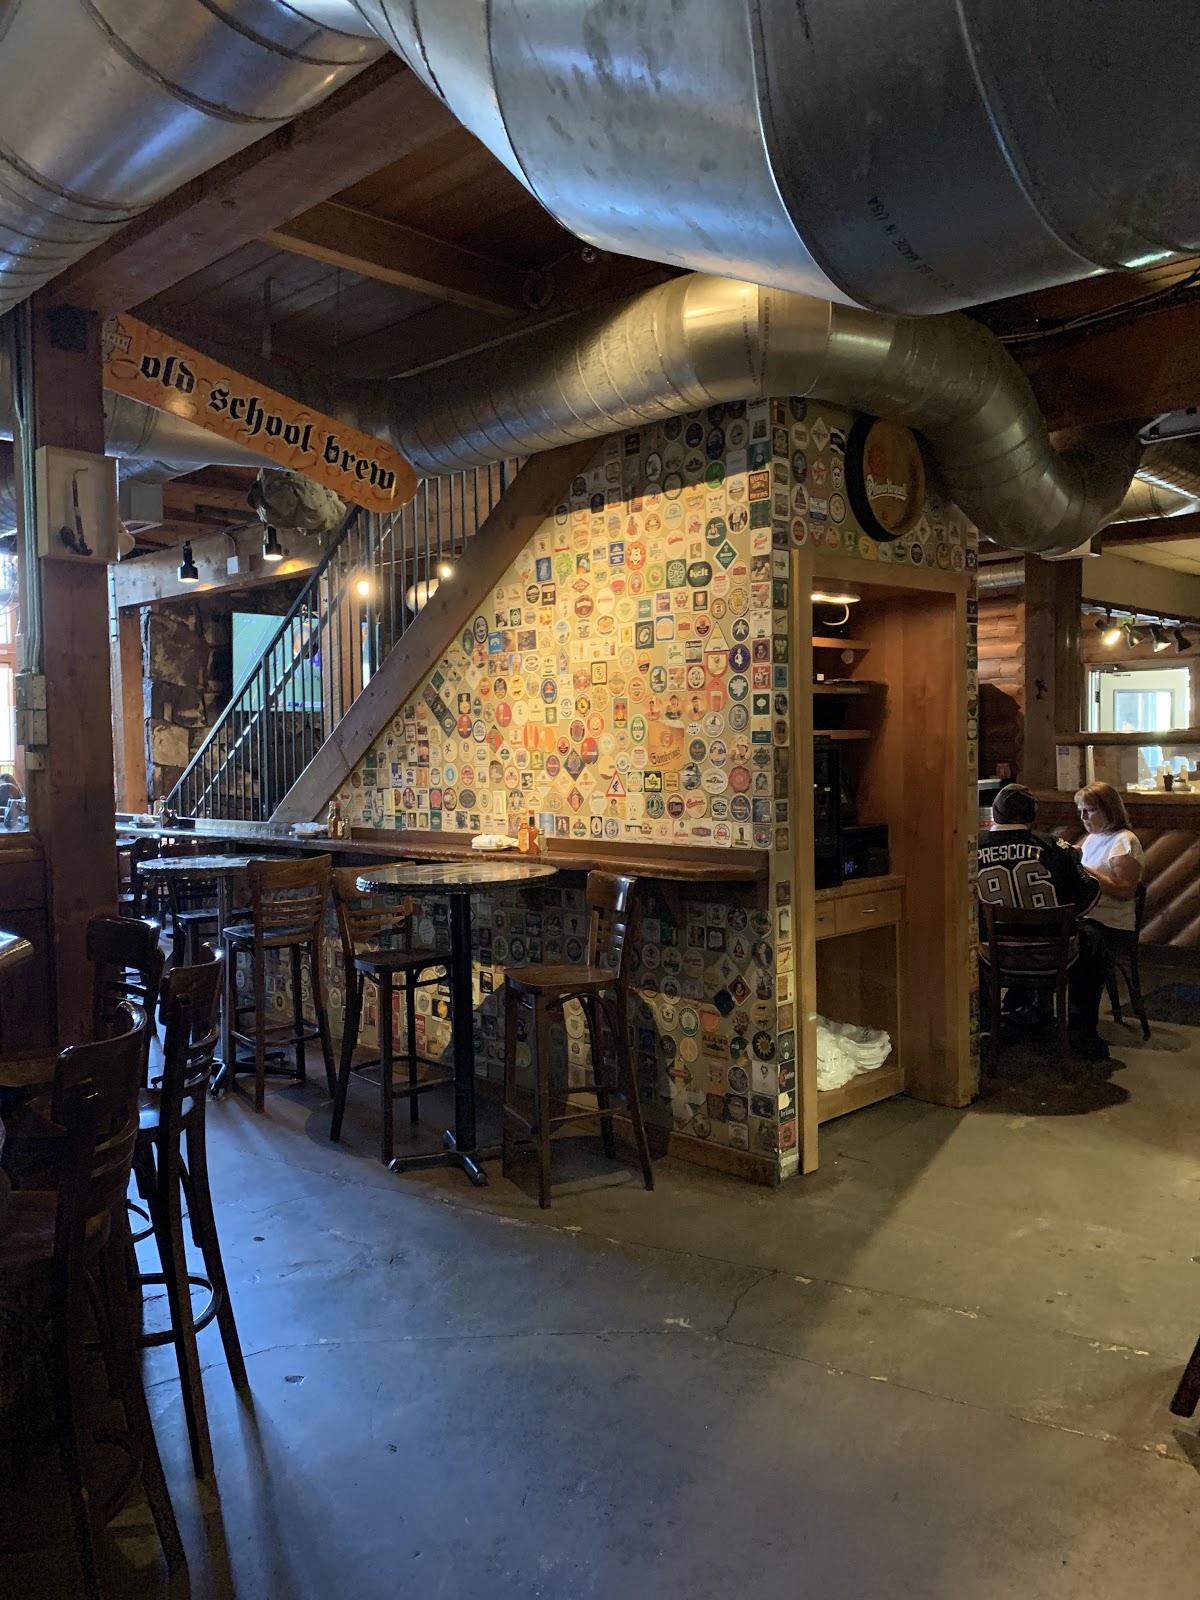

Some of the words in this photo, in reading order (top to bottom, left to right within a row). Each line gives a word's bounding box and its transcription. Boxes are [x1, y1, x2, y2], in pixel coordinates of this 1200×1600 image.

[140, 354, 195, 395] old
[208, 385, 315, 453] school
[323, 434, 396, 491] brew
[978, 844, 1044, 864] PRESCOTT
[977, 860, 1059, 909] 96
